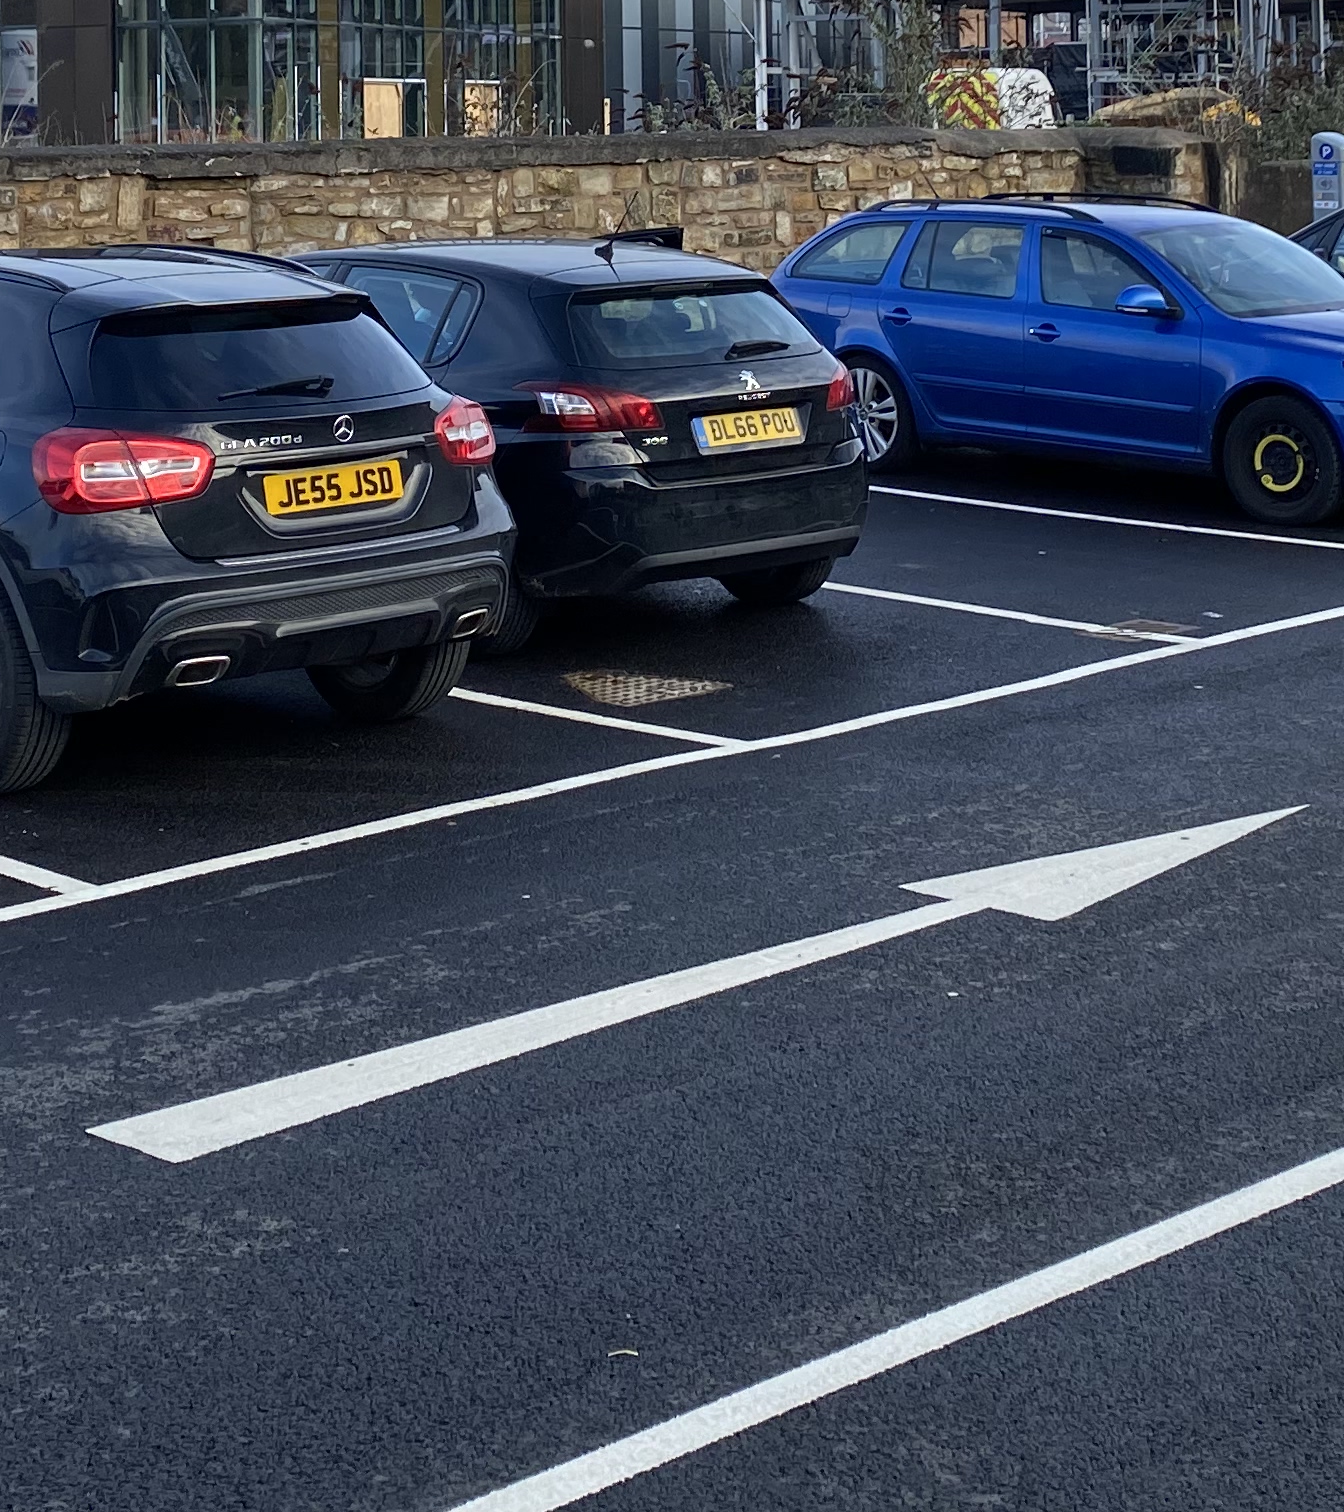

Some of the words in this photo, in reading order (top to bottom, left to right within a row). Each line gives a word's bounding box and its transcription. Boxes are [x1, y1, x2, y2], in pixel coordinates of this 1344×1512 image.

[709, 414, 758, 442] DL66
[760, 410, 796, 435] POU
[278, 476, 343, 508] JE55
[348, 466, 395, 500] JSD
